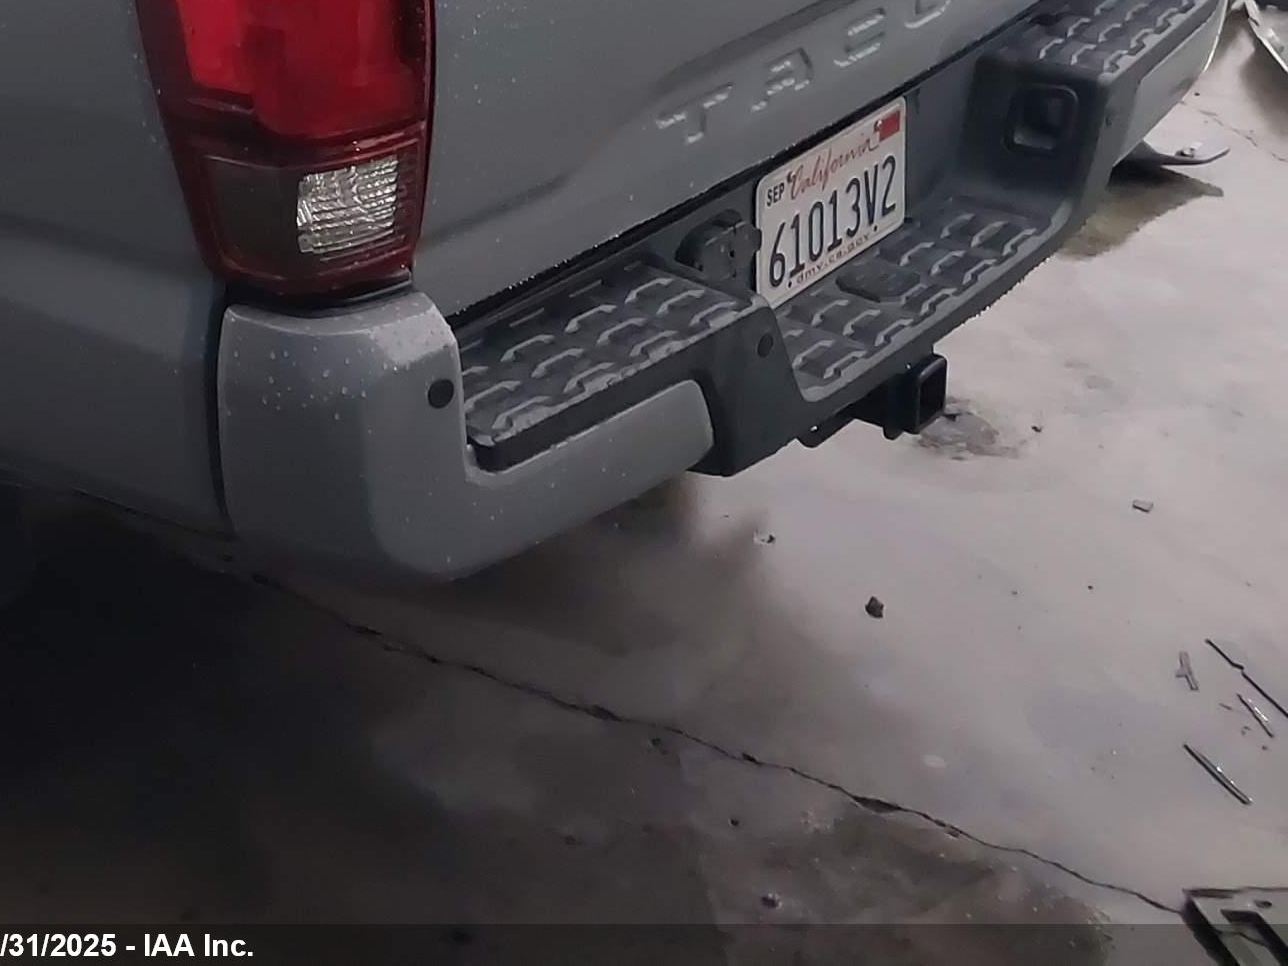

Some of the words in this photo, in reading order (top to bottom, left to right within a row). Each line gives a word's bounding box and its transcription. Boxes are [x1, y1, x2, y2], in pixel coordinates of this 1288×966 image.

[766, 182, 785, 207] SEP
[789, 135, 880, 200] California
[769, 154, 896, 287] 61013V2
